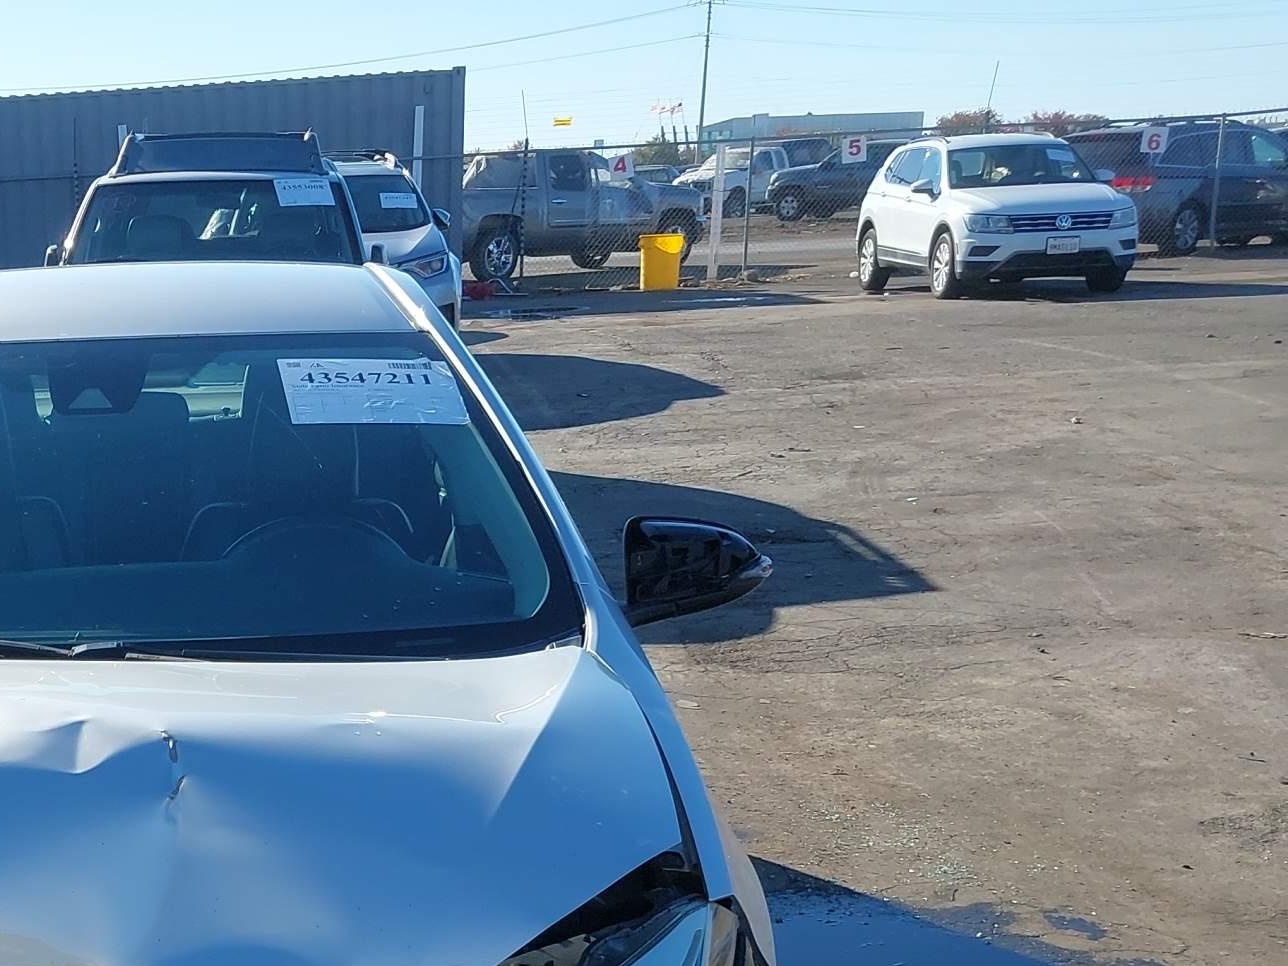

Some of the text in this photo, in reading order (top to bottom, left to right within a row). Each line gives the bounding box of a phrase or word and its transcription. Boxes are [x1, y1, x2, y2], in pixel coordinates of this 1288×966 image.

[848, 139, 861, 156] 5
[1147, 133, 1161, 151] 6
[613, 156, 627, 173] 4
[300, 372, 432, 385] 43547211
